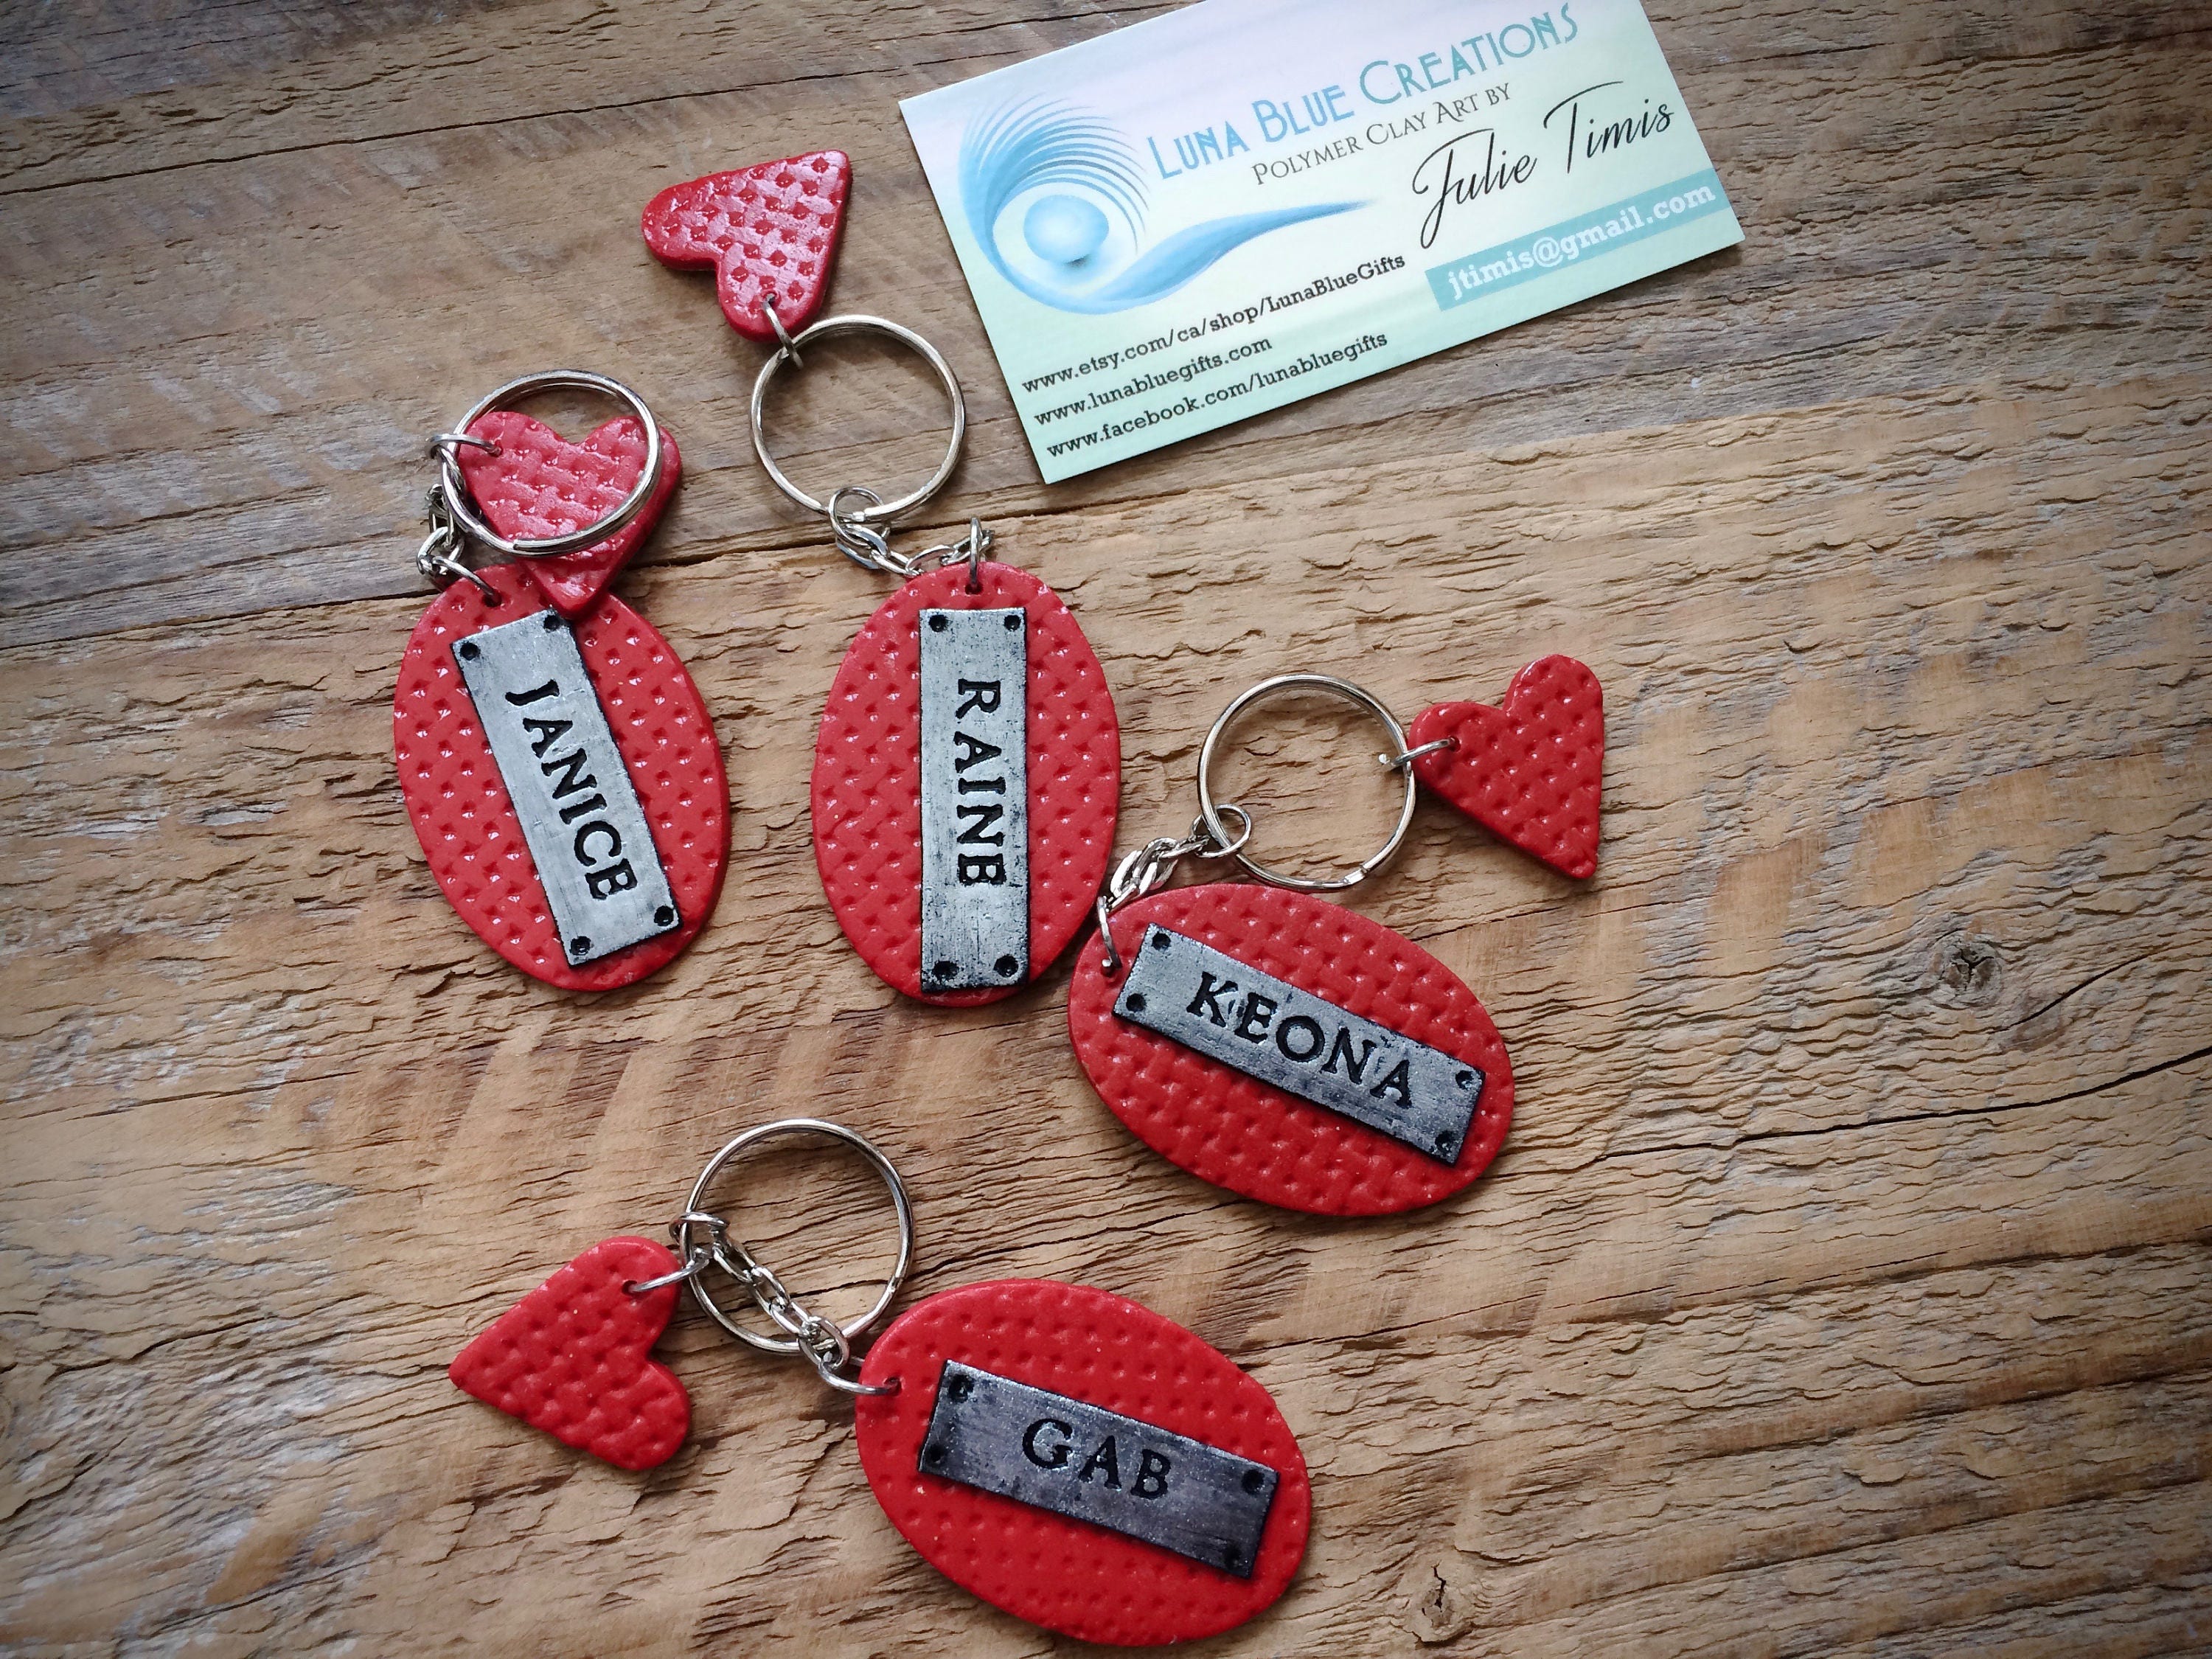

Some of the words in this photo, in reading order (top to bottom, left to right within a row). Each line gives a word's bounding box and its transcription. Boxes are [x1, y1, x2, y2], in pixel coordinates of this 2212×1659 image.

[1147, 122, 1250, 180] LUNA
[1252, 86, 1355, 142] BLUE
[1360, 2, 1579, 105] CREATIONS
[1251, 136, 1364, 185] POLYMER
[1365, 111, 1430, 147] CLAY
[1433, 94, 1480, 125] ART
[1412, 128, 1537, 249] Julie
[1543, 80, 1674, 174] Timis
[1447, 183, 1716, 301] jtimis@gmail.com
[1022, 254, 1406, 394] www.etsy.com/ca/shop/LunaBlueGifts
[1034, 336, 1273, 425] www.lunabluegifts.com
[1046, 330, 1388, 458] www.facebook.com/lunabluegifts
[504, 679, 639, 901] JANICE
[1186, 971, 1413, 1110] KEONA
[1022, 1418, 1172, 1499] GAB
